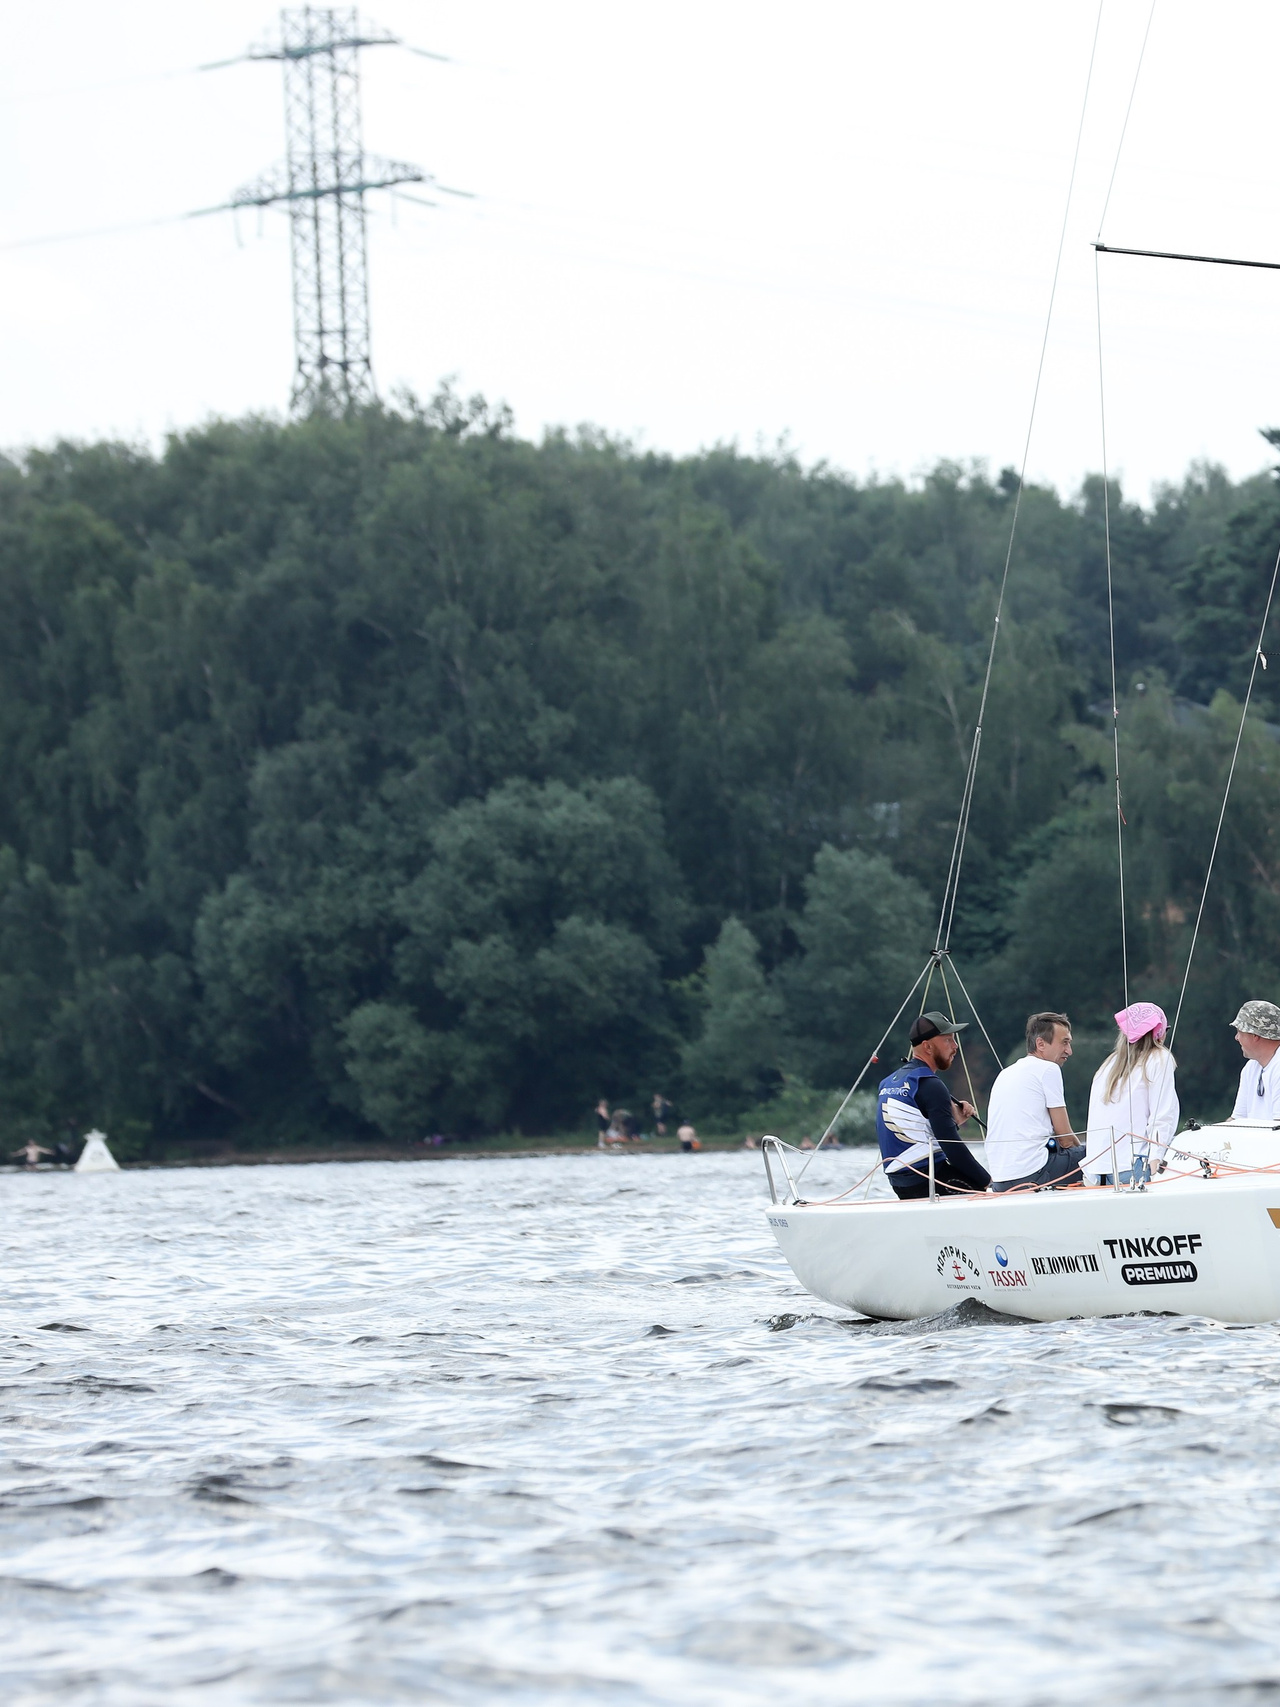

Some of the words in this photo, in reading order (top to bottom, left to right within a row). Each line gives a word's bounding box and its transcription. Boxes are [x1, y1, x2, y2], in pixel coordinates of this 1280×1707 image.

[1103, 1233, 1203, 1259] TINKOFF
[936, 1245, 980, 1277] МОРПРИБОР
[1031, 1253, 1100, 1276] ВЕДОМОСТИ
[988, 1270, 1028, 1287] TASSAY
[1124, 1264, 1194, 1282] PREMIUM
